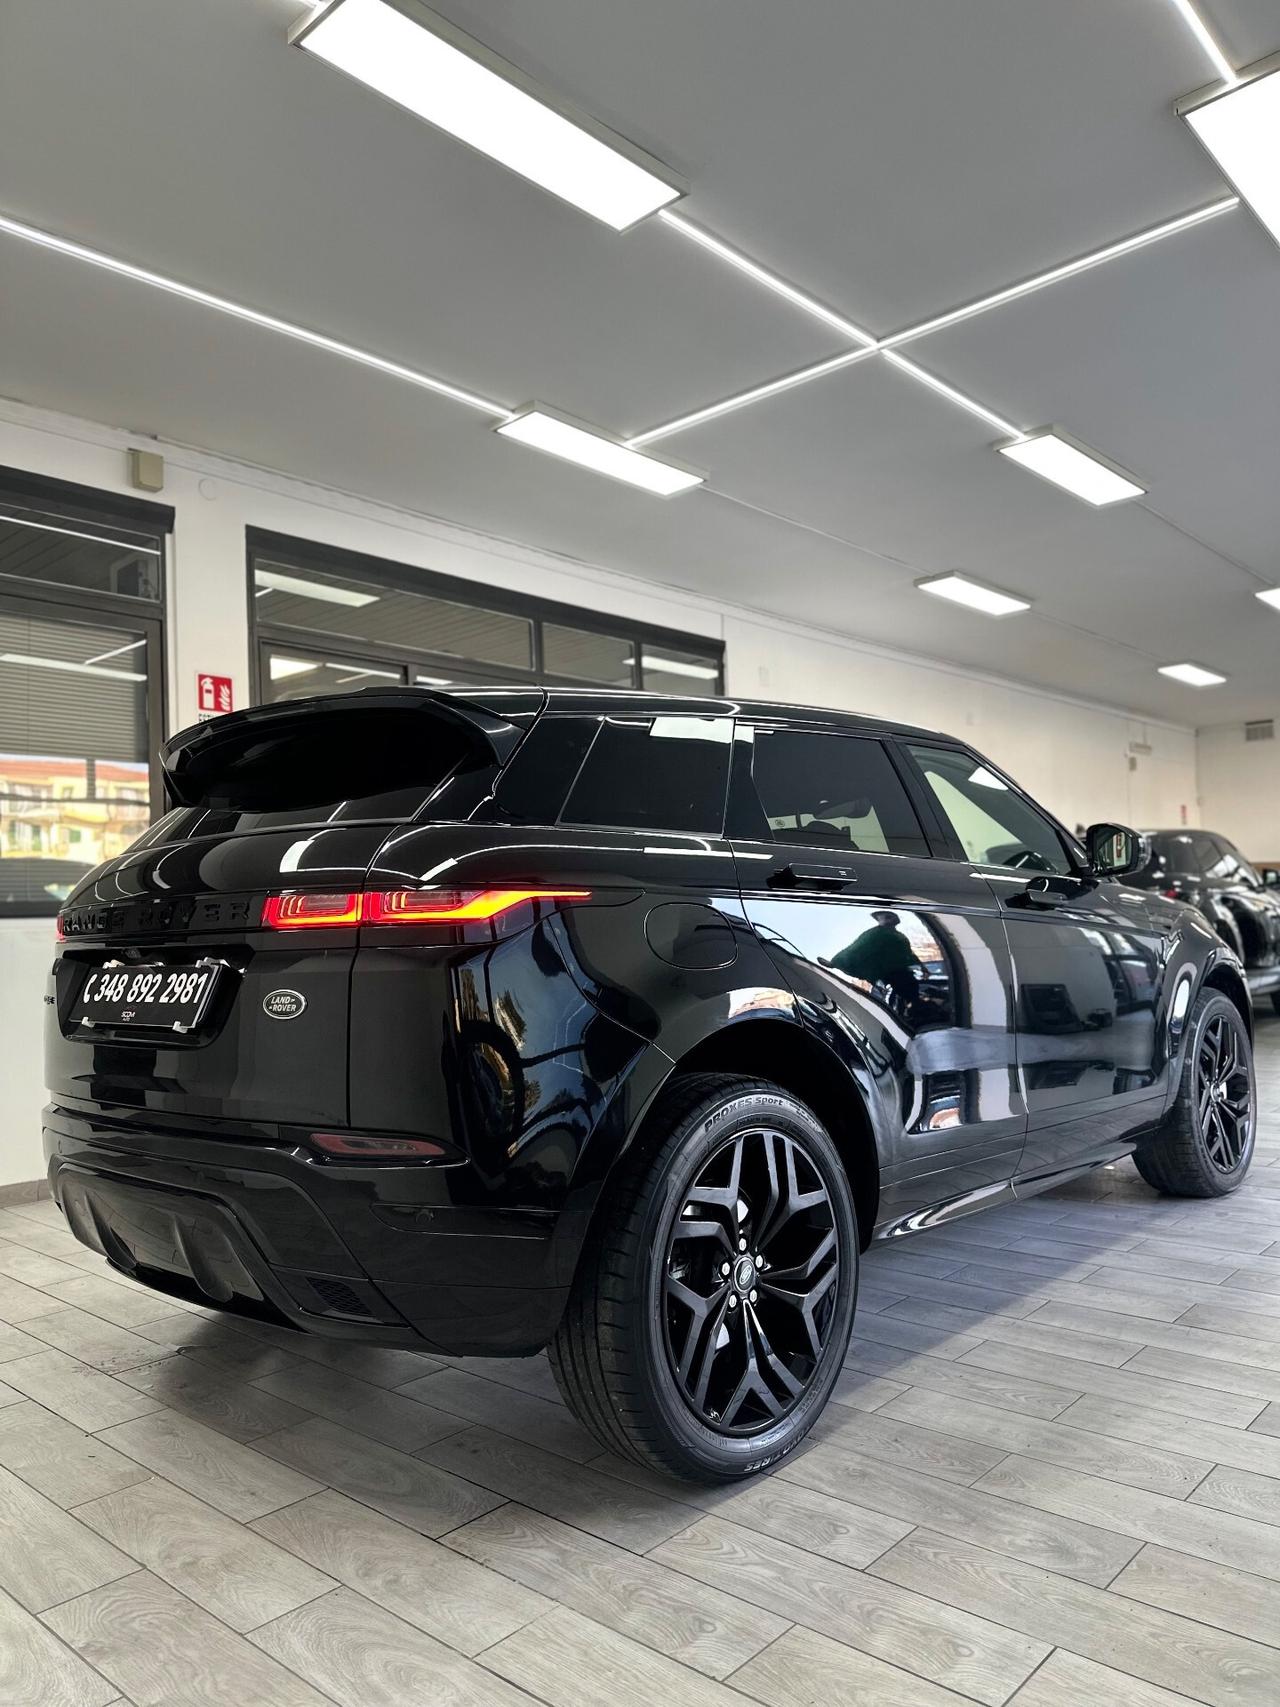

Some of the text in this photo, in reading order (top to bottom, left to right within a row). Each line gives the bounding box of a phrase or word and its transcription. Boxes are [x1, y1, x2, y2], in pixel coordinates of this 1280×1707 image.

[94, 973, 209, 1004] 348 892 2981
[271, 996, 291, 1004] LAND
[272, 1004, 297, 1012] ROVER
[704, 1097, 753, 1132] PROXES
[755, 1096, 784, 1107] Sport
